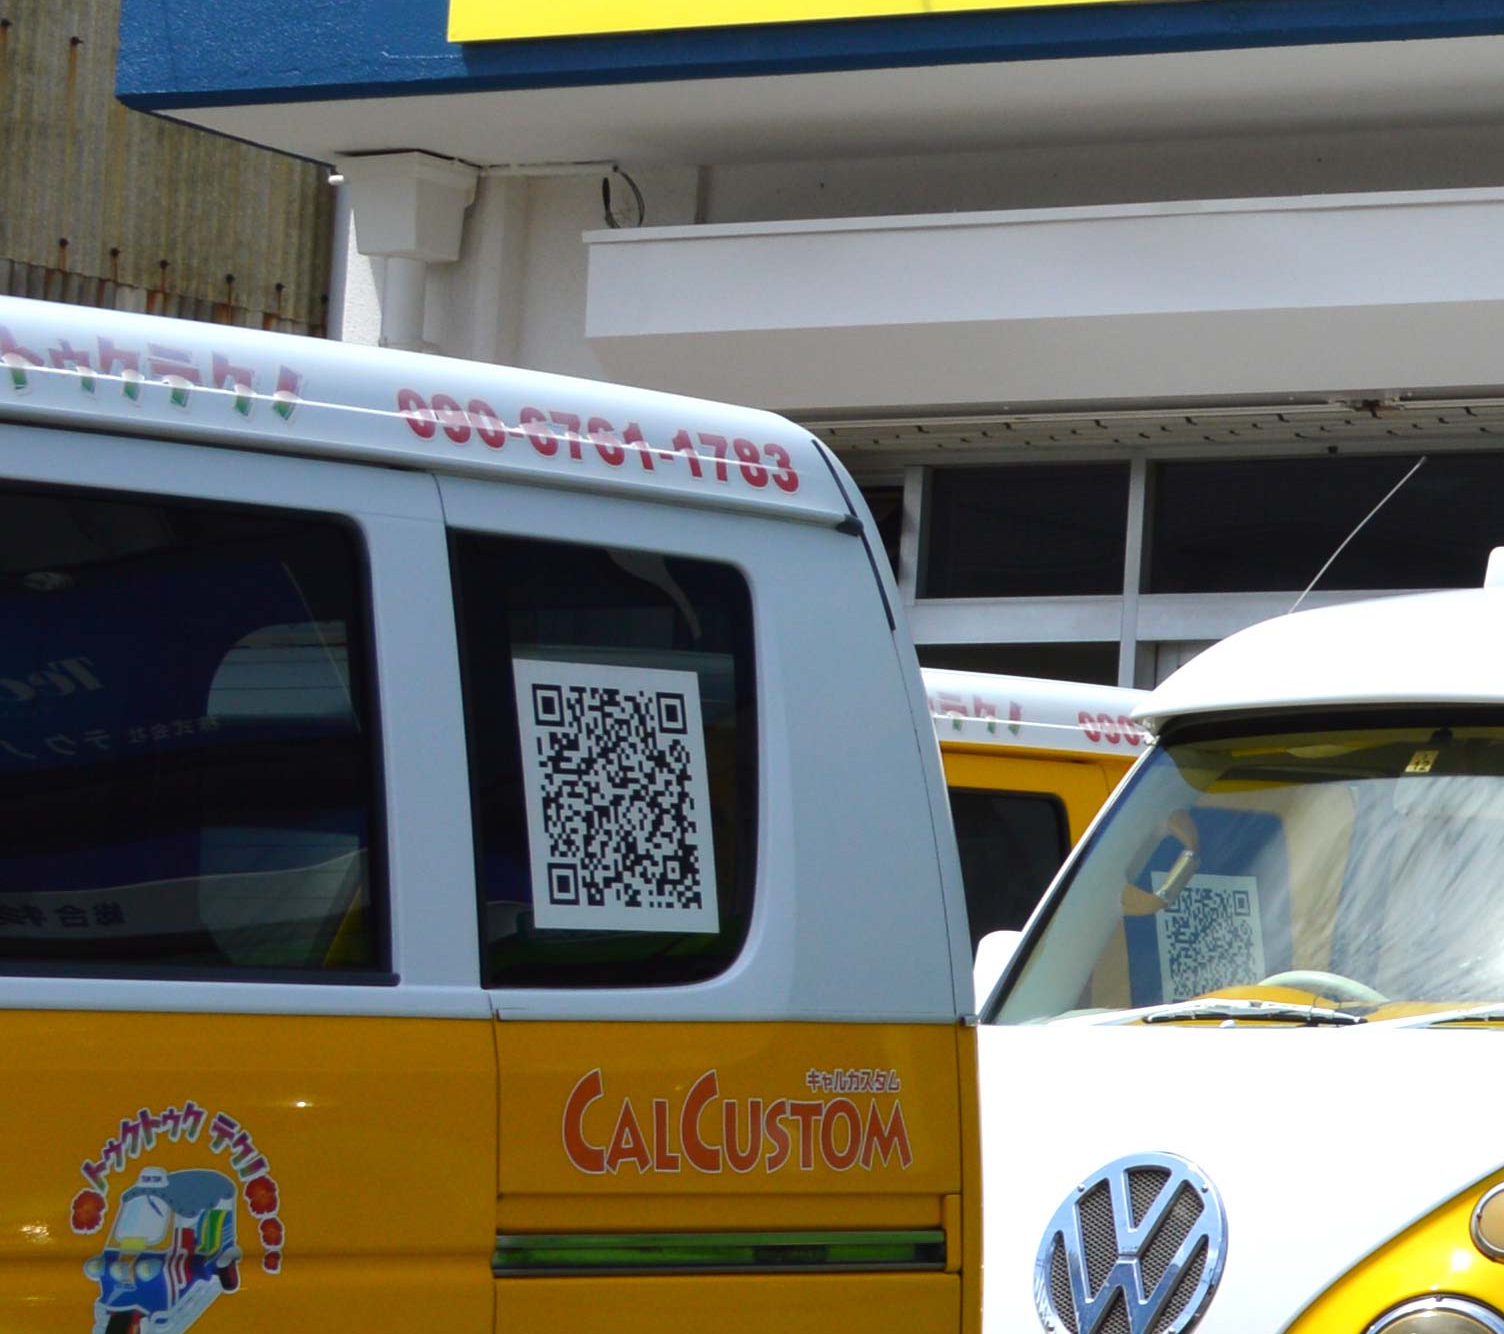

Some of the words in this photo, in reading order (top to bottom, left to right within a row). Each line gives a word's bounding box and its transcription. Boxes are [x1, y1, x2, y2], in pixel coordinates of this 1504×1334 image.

[397, 386, 800, 496] 090-6761-1783
[806, 1069, 900, 1093] キャルカスタム
[81, 1100, 207, 1195] トゥクトゥク
[210, 1111, 270, 1182] テクノ
